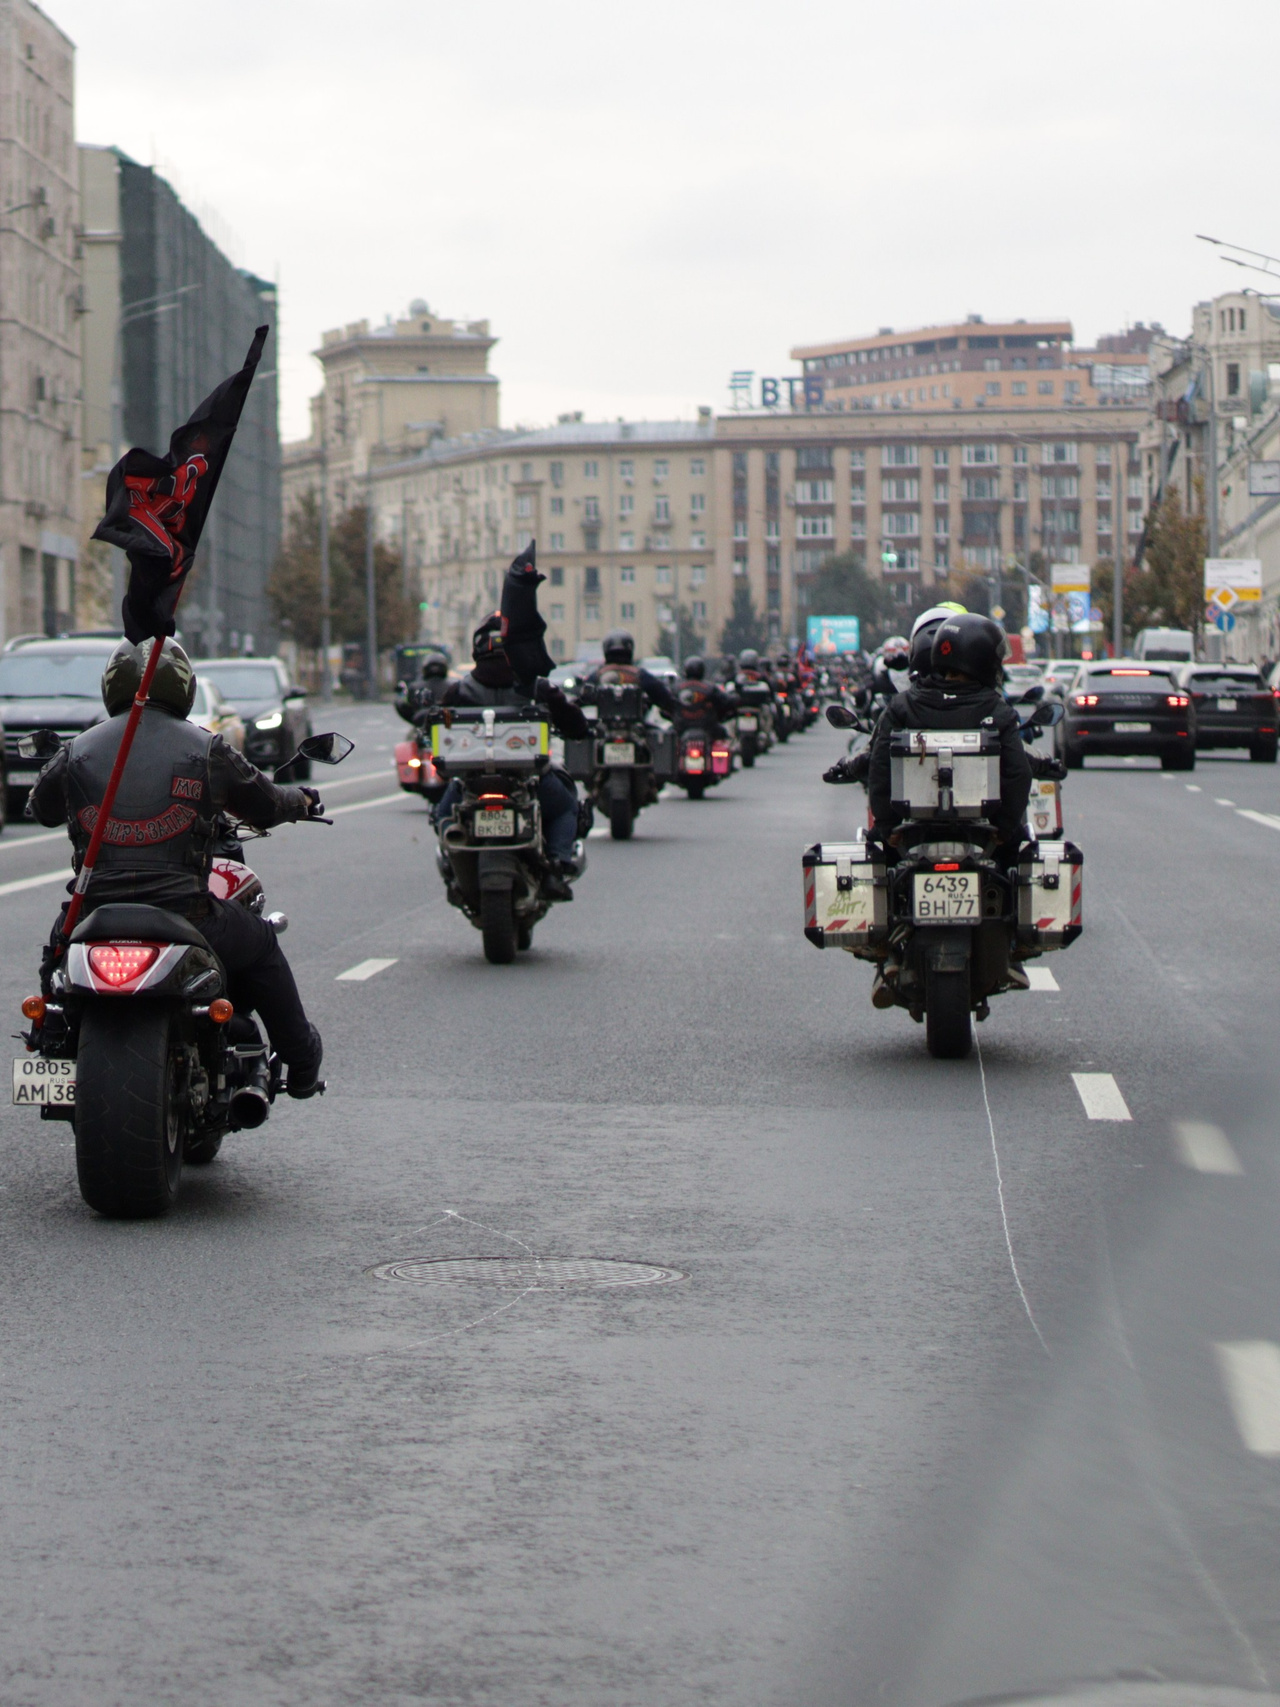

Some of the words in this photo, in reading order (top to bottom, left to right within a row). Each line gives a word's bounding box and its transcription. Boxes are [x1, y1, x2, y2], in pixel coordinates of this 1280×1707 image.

[762, 377, 824, 406] ВТБ
[147, 804, 196, 840] ЗАПАД
[923, 876, 969, 893] 6439
[953, 899, 975, 915] 77
[22, 1061, 71, 1076] 0805
[53, 1084, 76, 1101] 38
